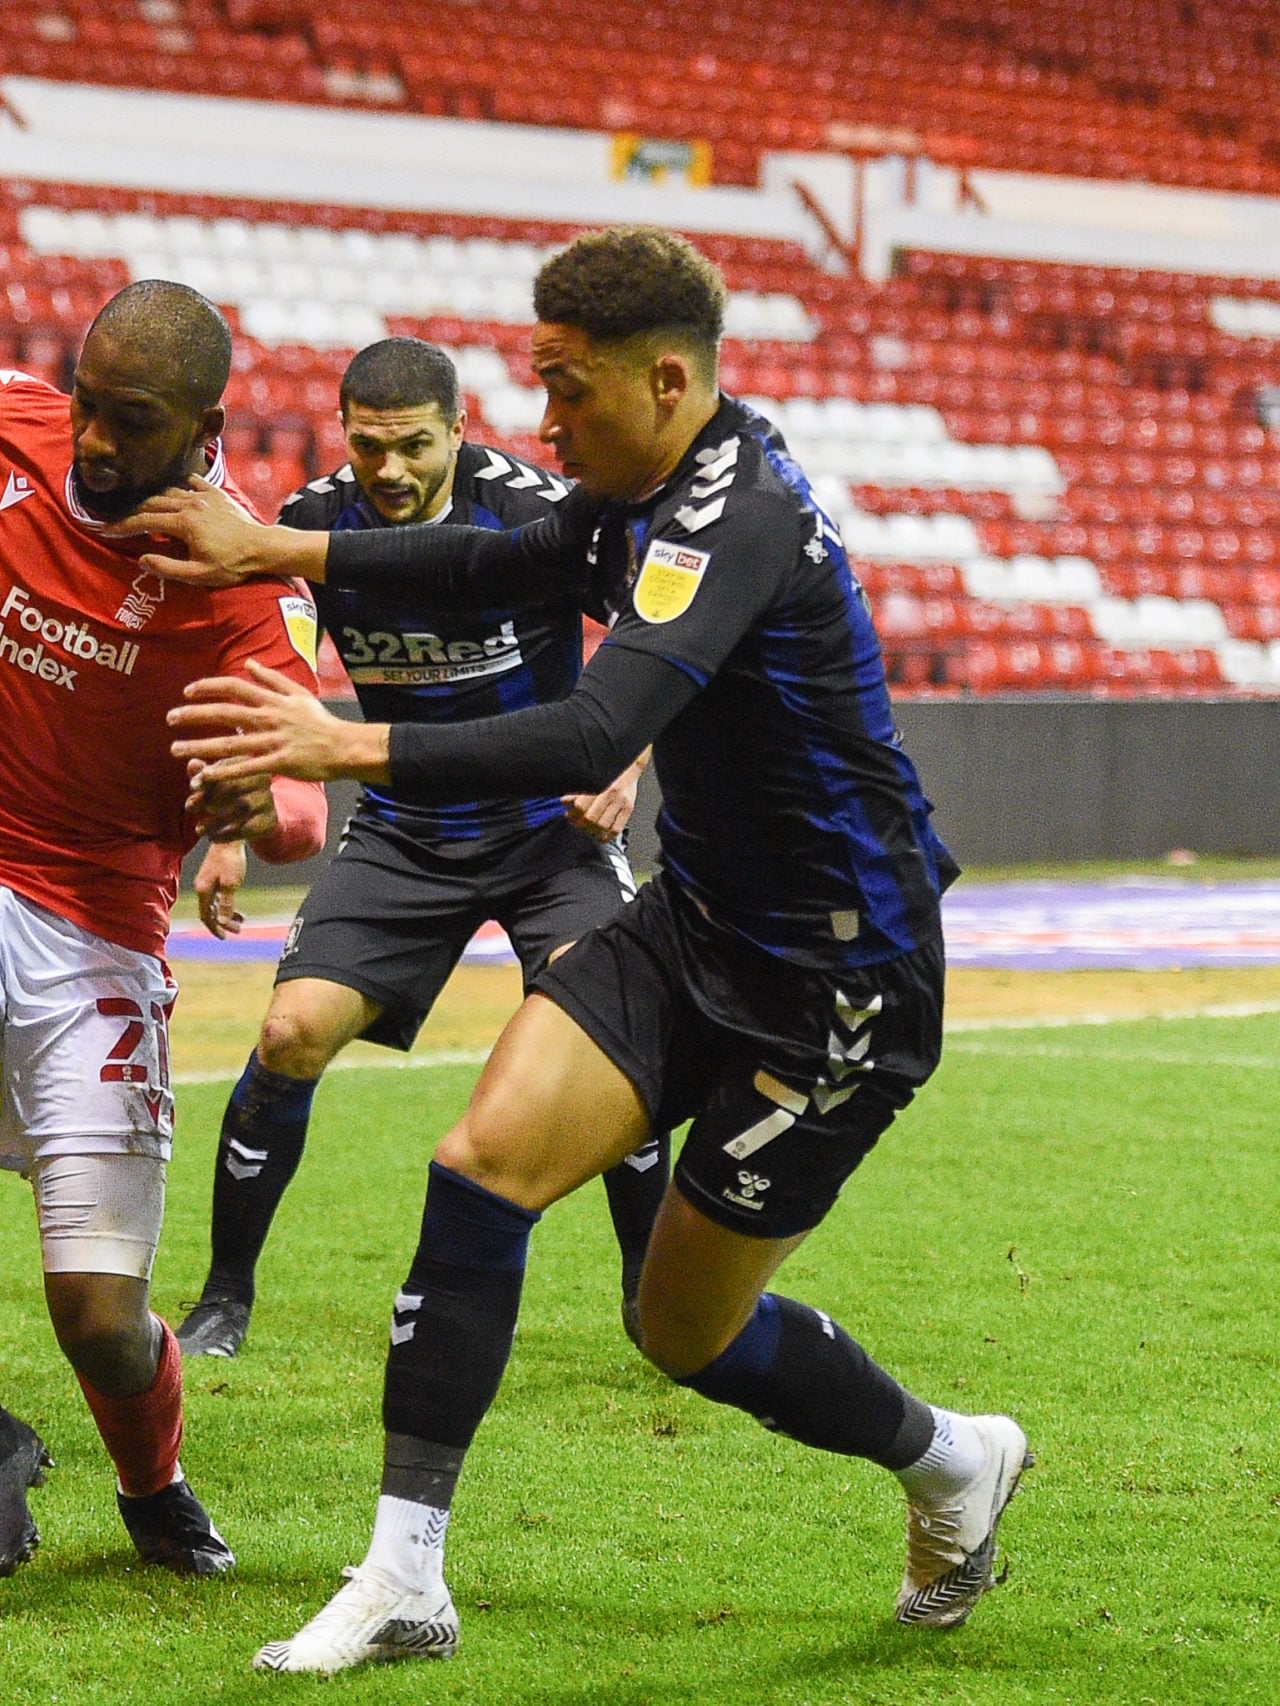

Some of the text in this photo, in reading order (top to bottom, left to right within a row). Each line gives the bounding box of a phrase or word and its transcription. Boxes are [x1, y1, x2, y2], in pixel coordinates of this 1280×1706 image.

[0, 586, 140, 676] Football
[342, 620, 519, 665] 32Red
[722, 1069, 810, 1161] 7
